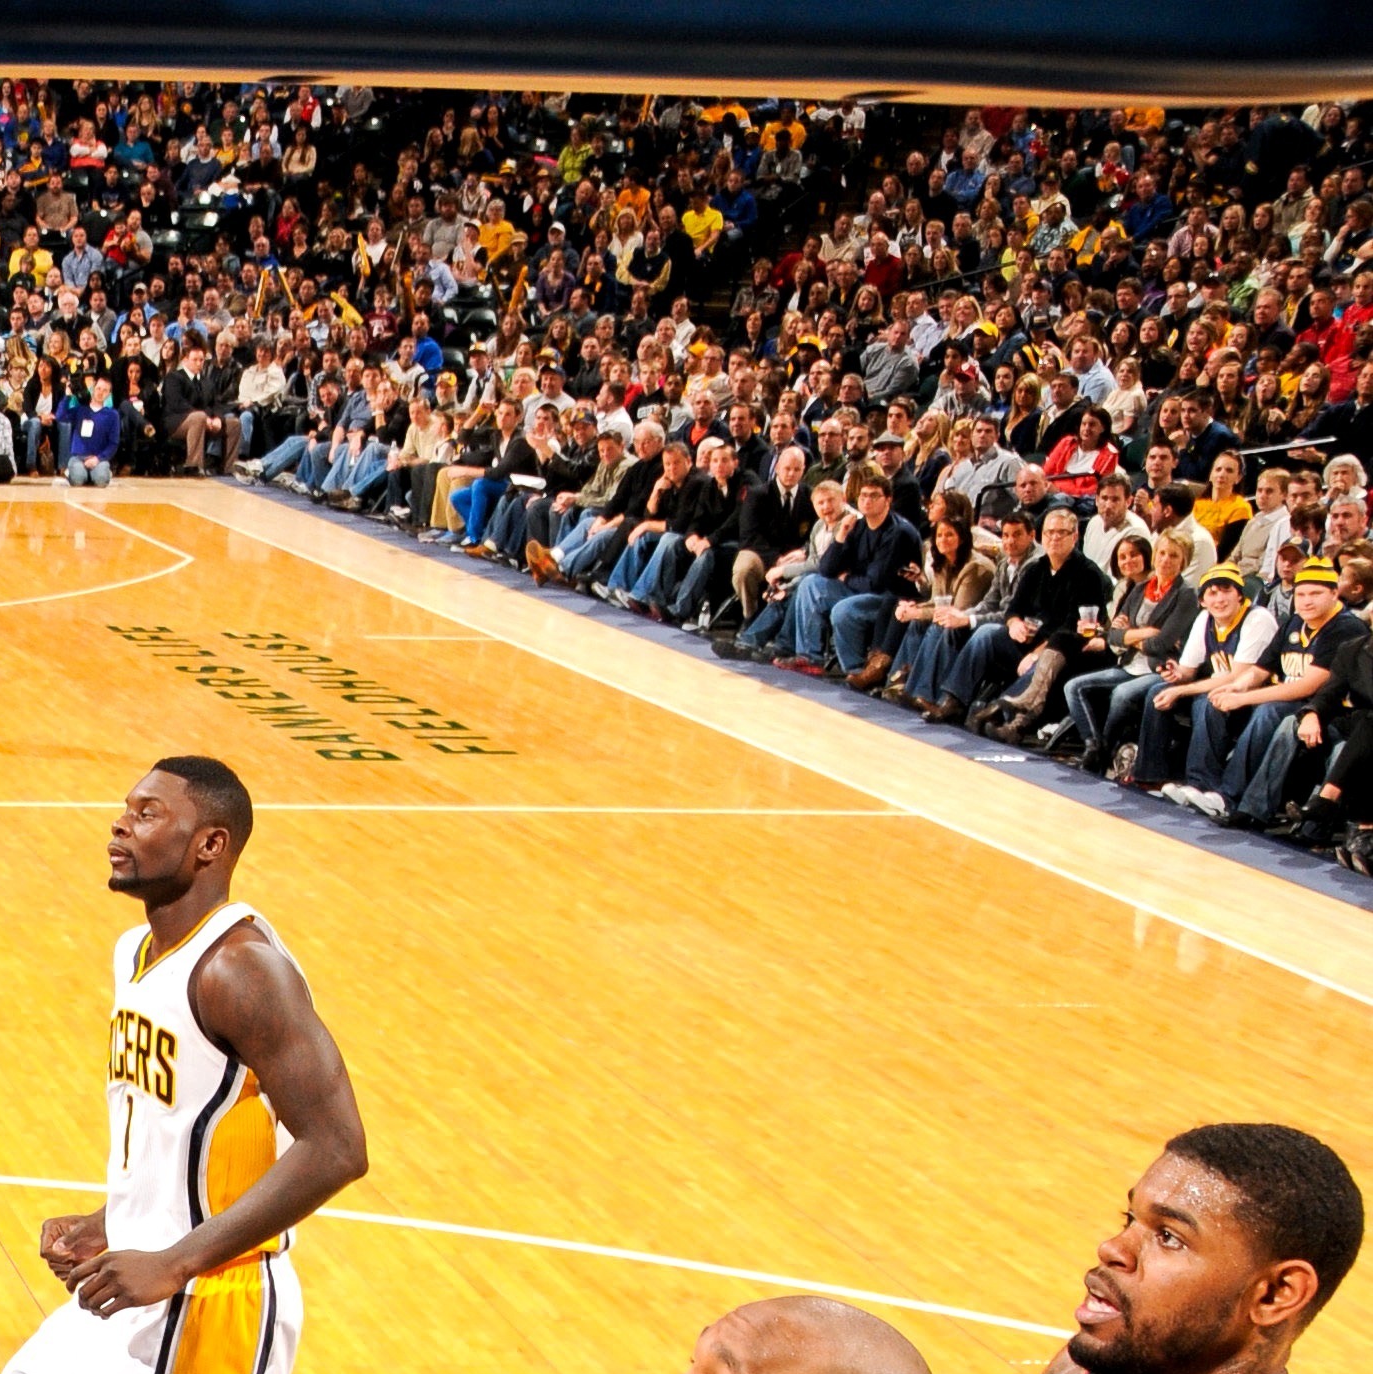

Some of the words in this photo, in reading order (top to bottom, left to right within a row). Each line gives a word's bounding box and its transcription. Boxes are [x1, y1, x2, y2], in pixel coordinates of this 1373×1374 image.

[106, 625, 217, 657] LIFE
[175, 666, 403, 762] BANKERS
[221, 632, 519, 755] FIELDHOUSE
[108, 1007, 179, 1110] CERS
[119, 1091, 136, 1173] 1
